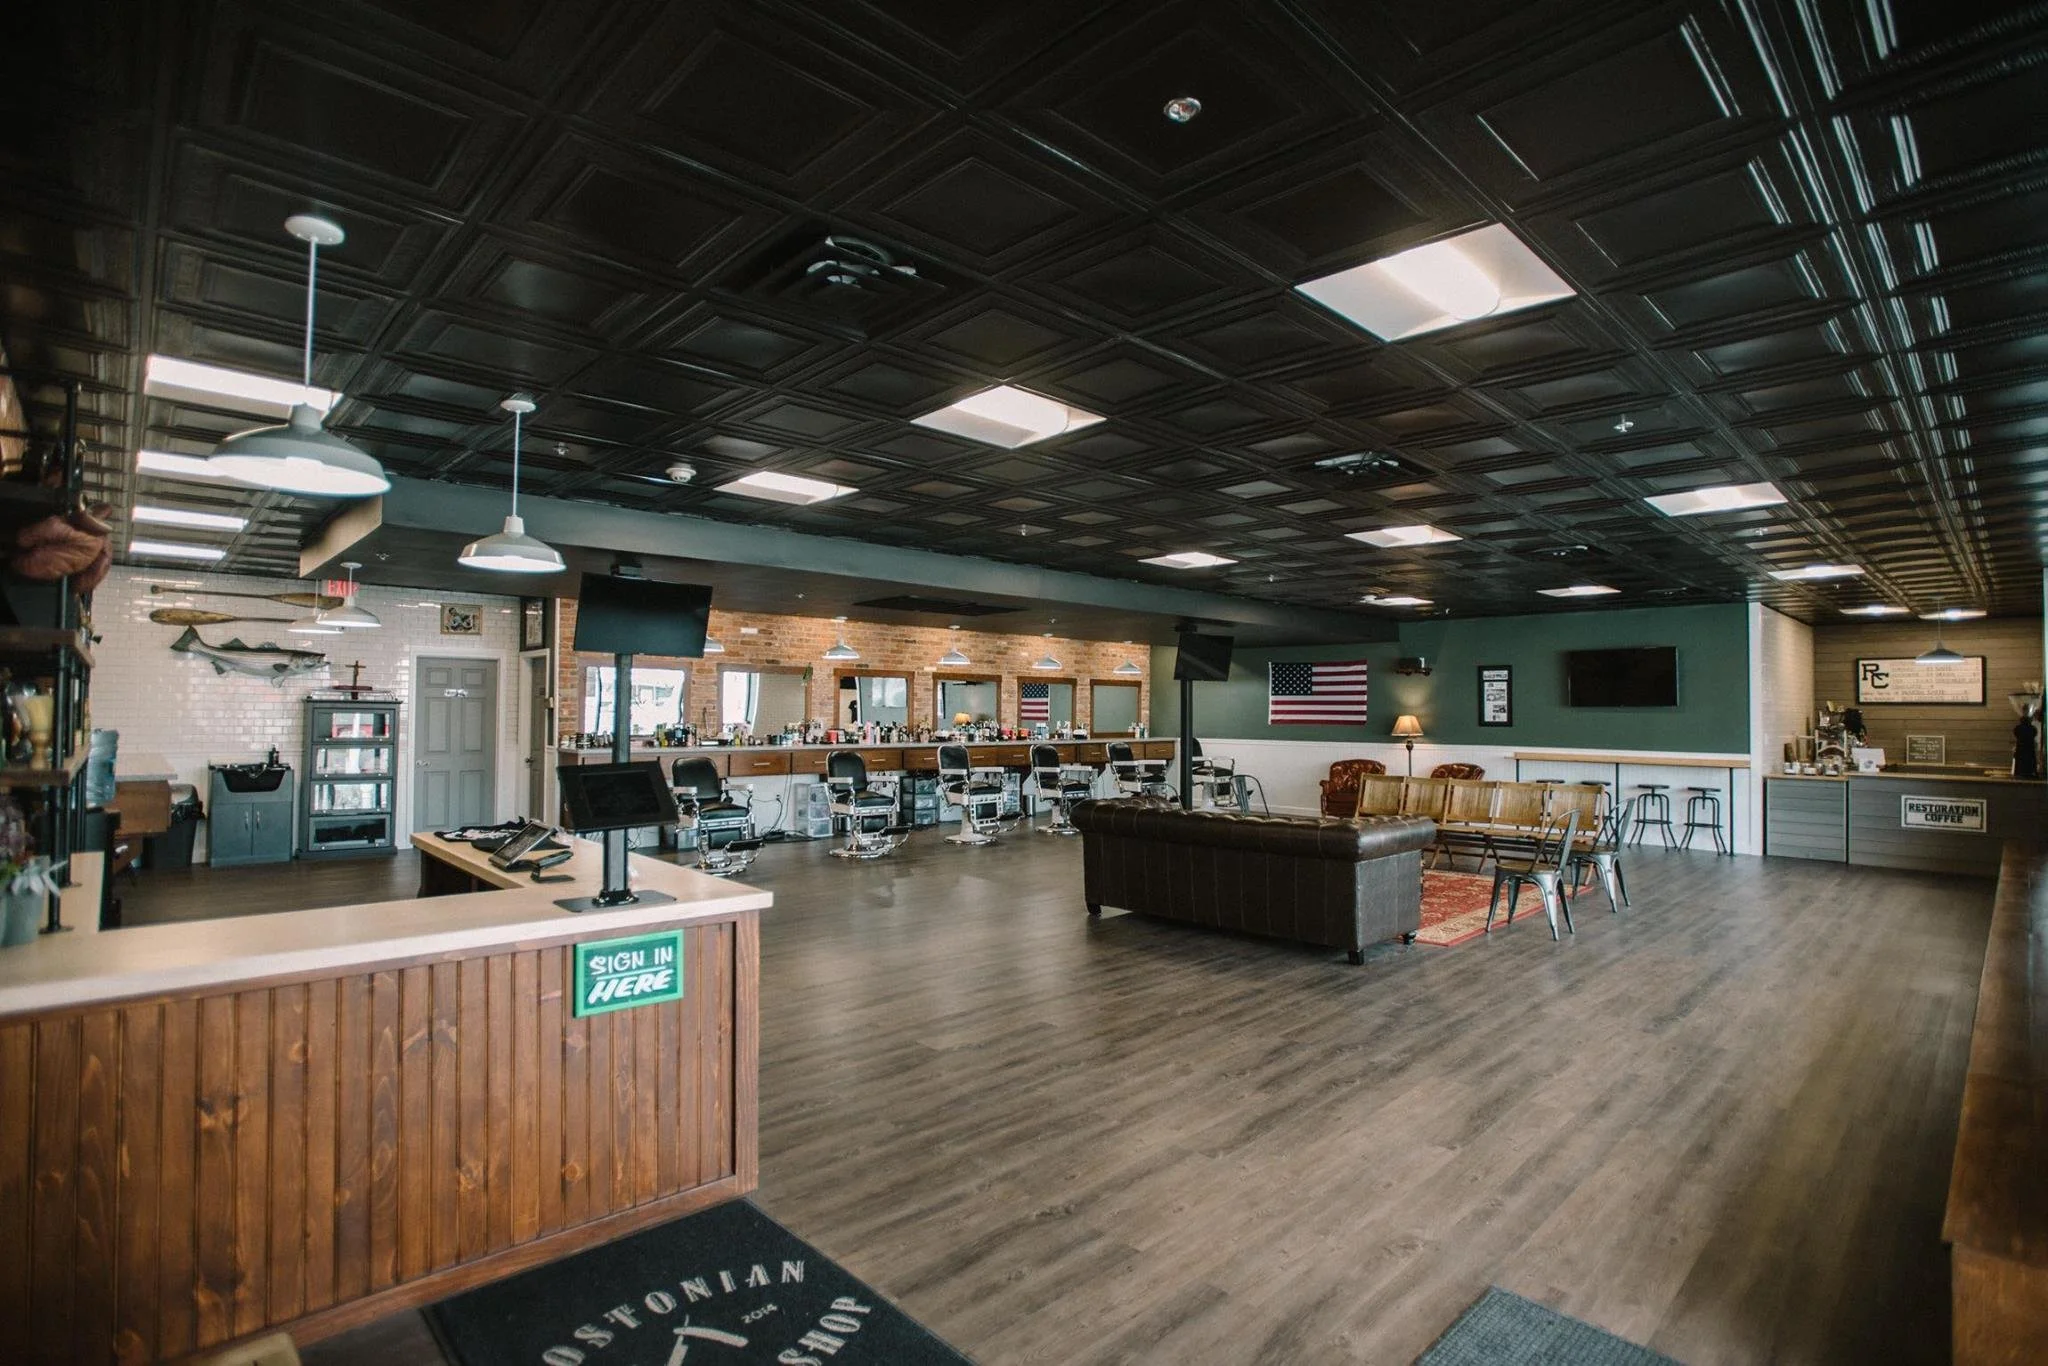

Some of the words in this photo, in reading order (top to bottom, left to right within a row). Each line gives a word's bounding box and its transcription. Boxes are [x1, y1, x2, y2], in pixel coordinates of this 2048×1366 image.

[1861, 663, 1889, 689] RC
[1908, 803, 1979, 817] RESTORATION
[1925, 813, 1963, 824] COFFEE
[589, 950, 645, 975] SIGN
[653, 945, 673, 966] IN
[587, 969, 675, 1005] HERE
[777, 1296, 872, 1366] SHOP
